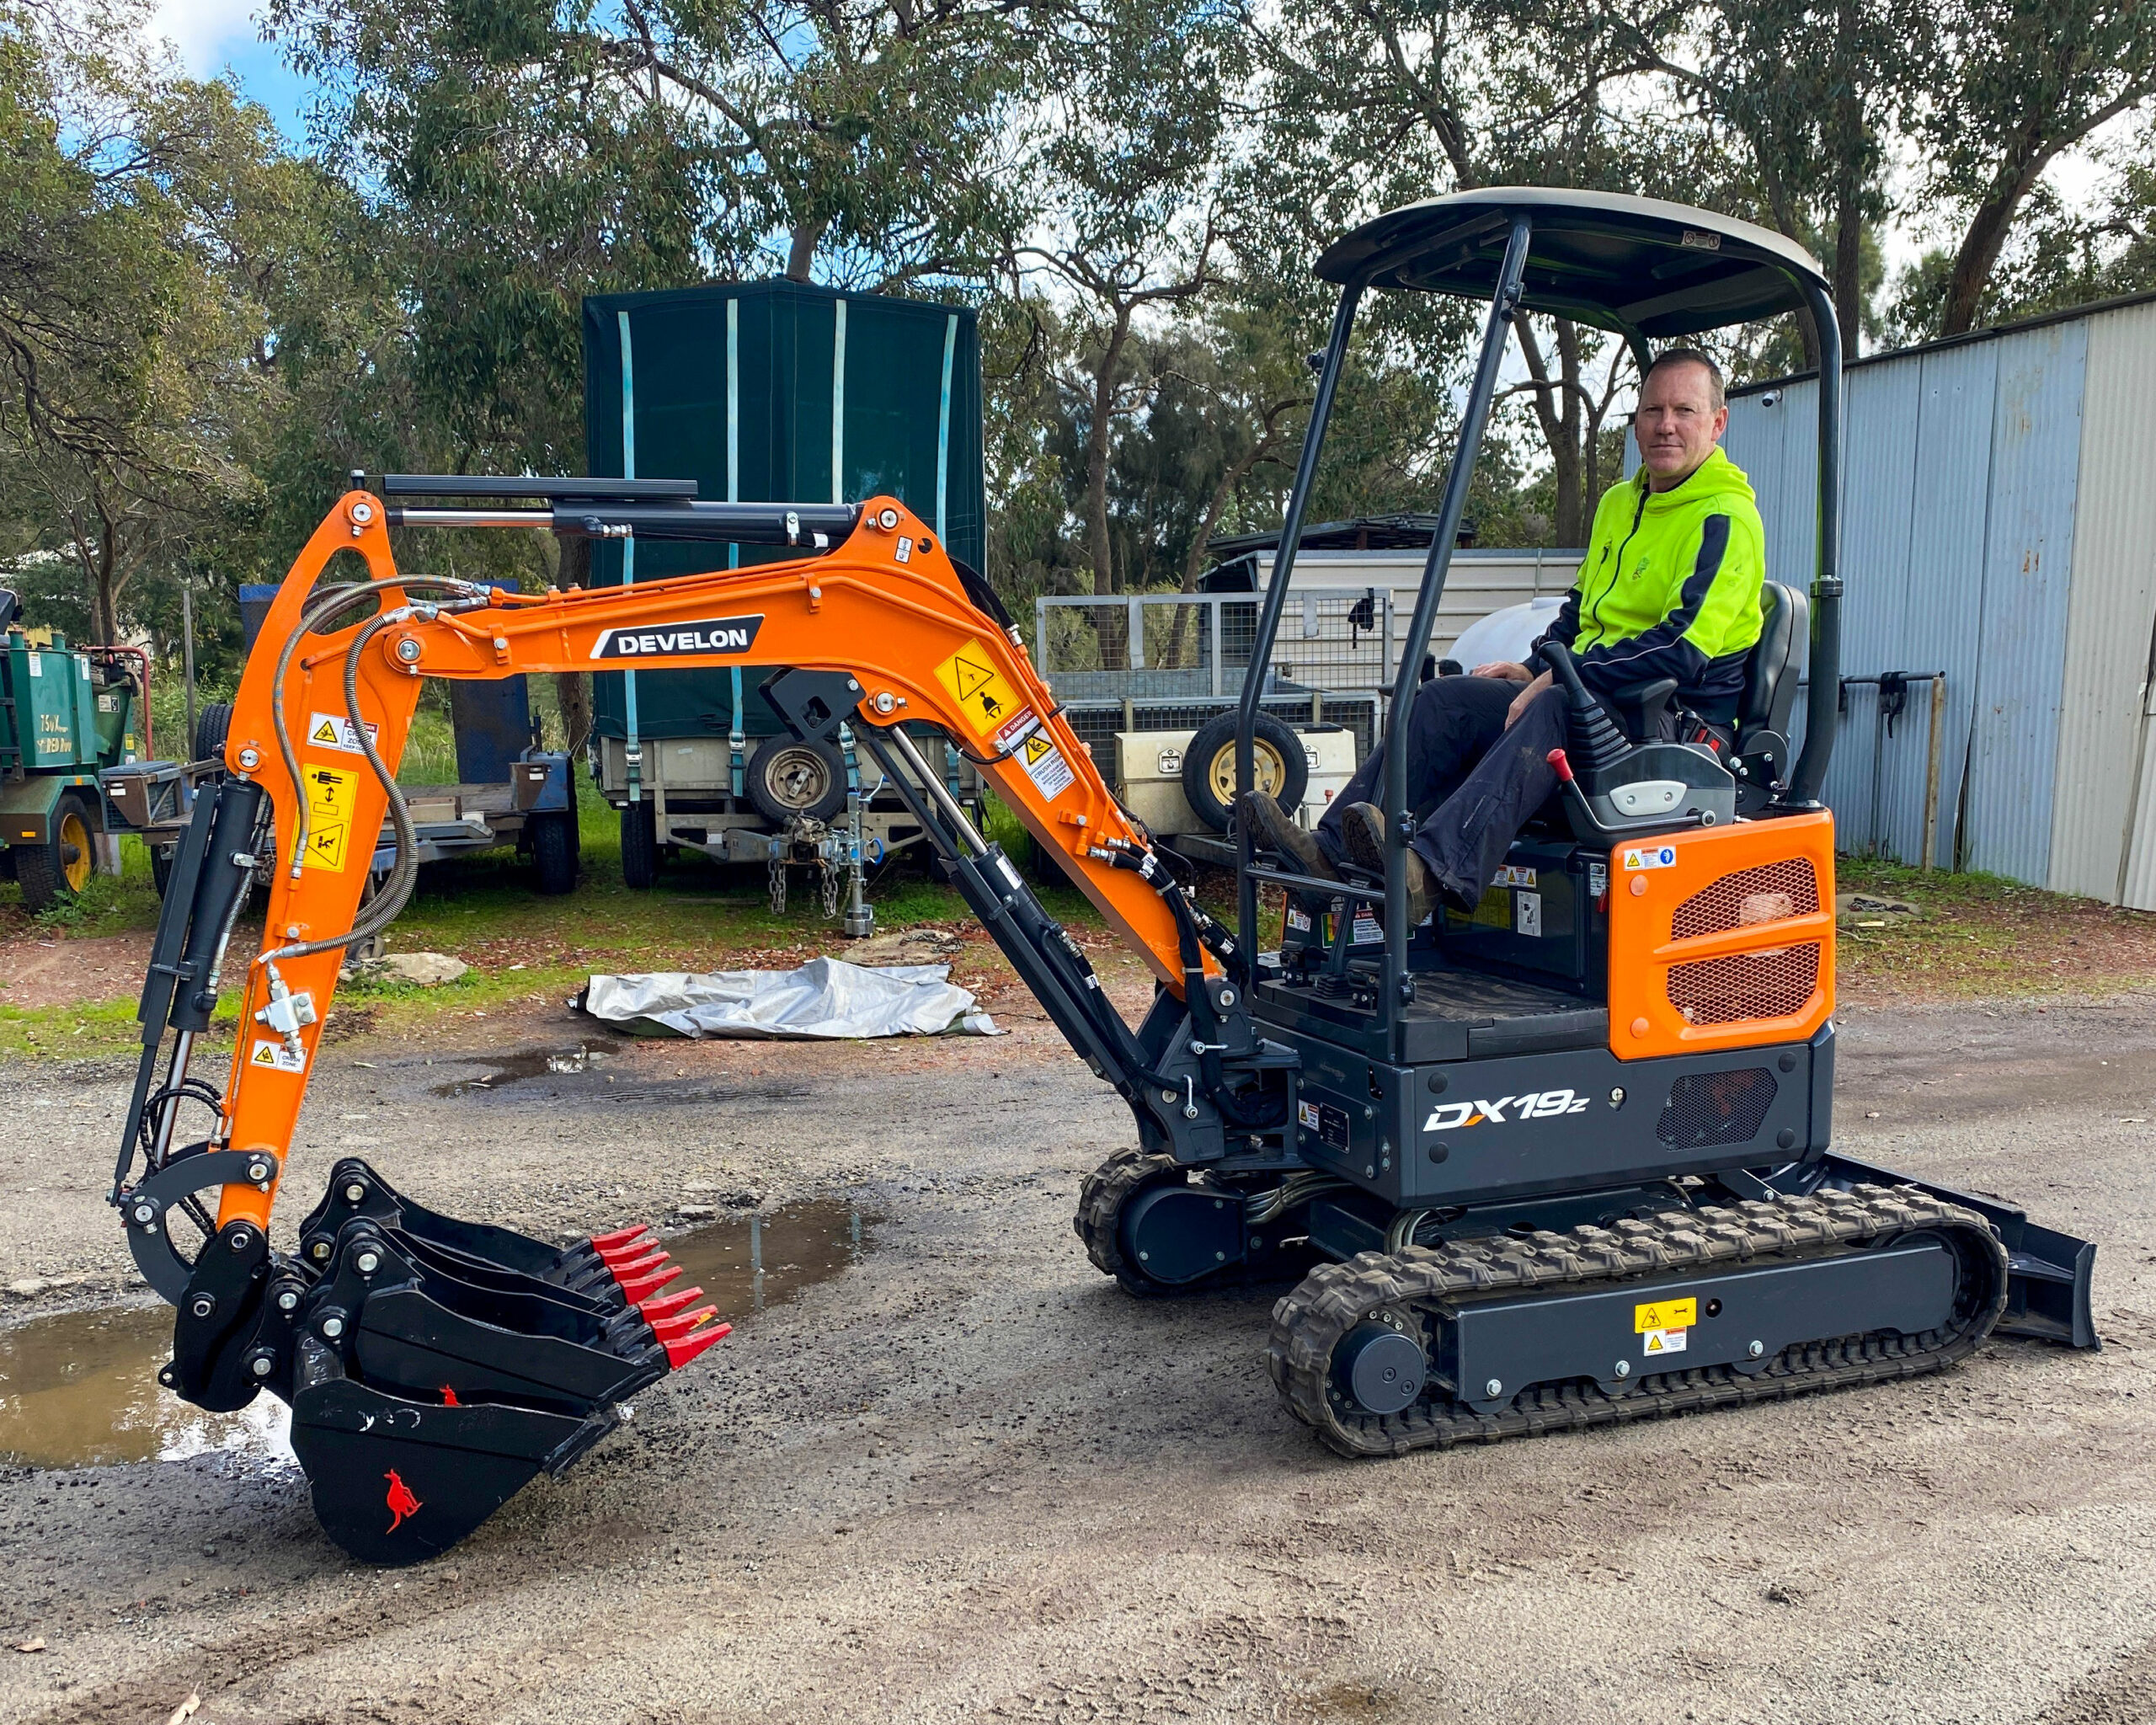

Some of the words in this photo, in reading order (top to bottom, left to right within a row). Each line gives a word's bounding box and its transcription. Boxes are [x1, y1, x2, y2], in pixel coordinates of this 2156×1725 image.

[618, 629, 748, 654] DEVELON
[1010, 710, 1033, 731] DANGER
[1034, 762, 1052, 779] CRUSH
